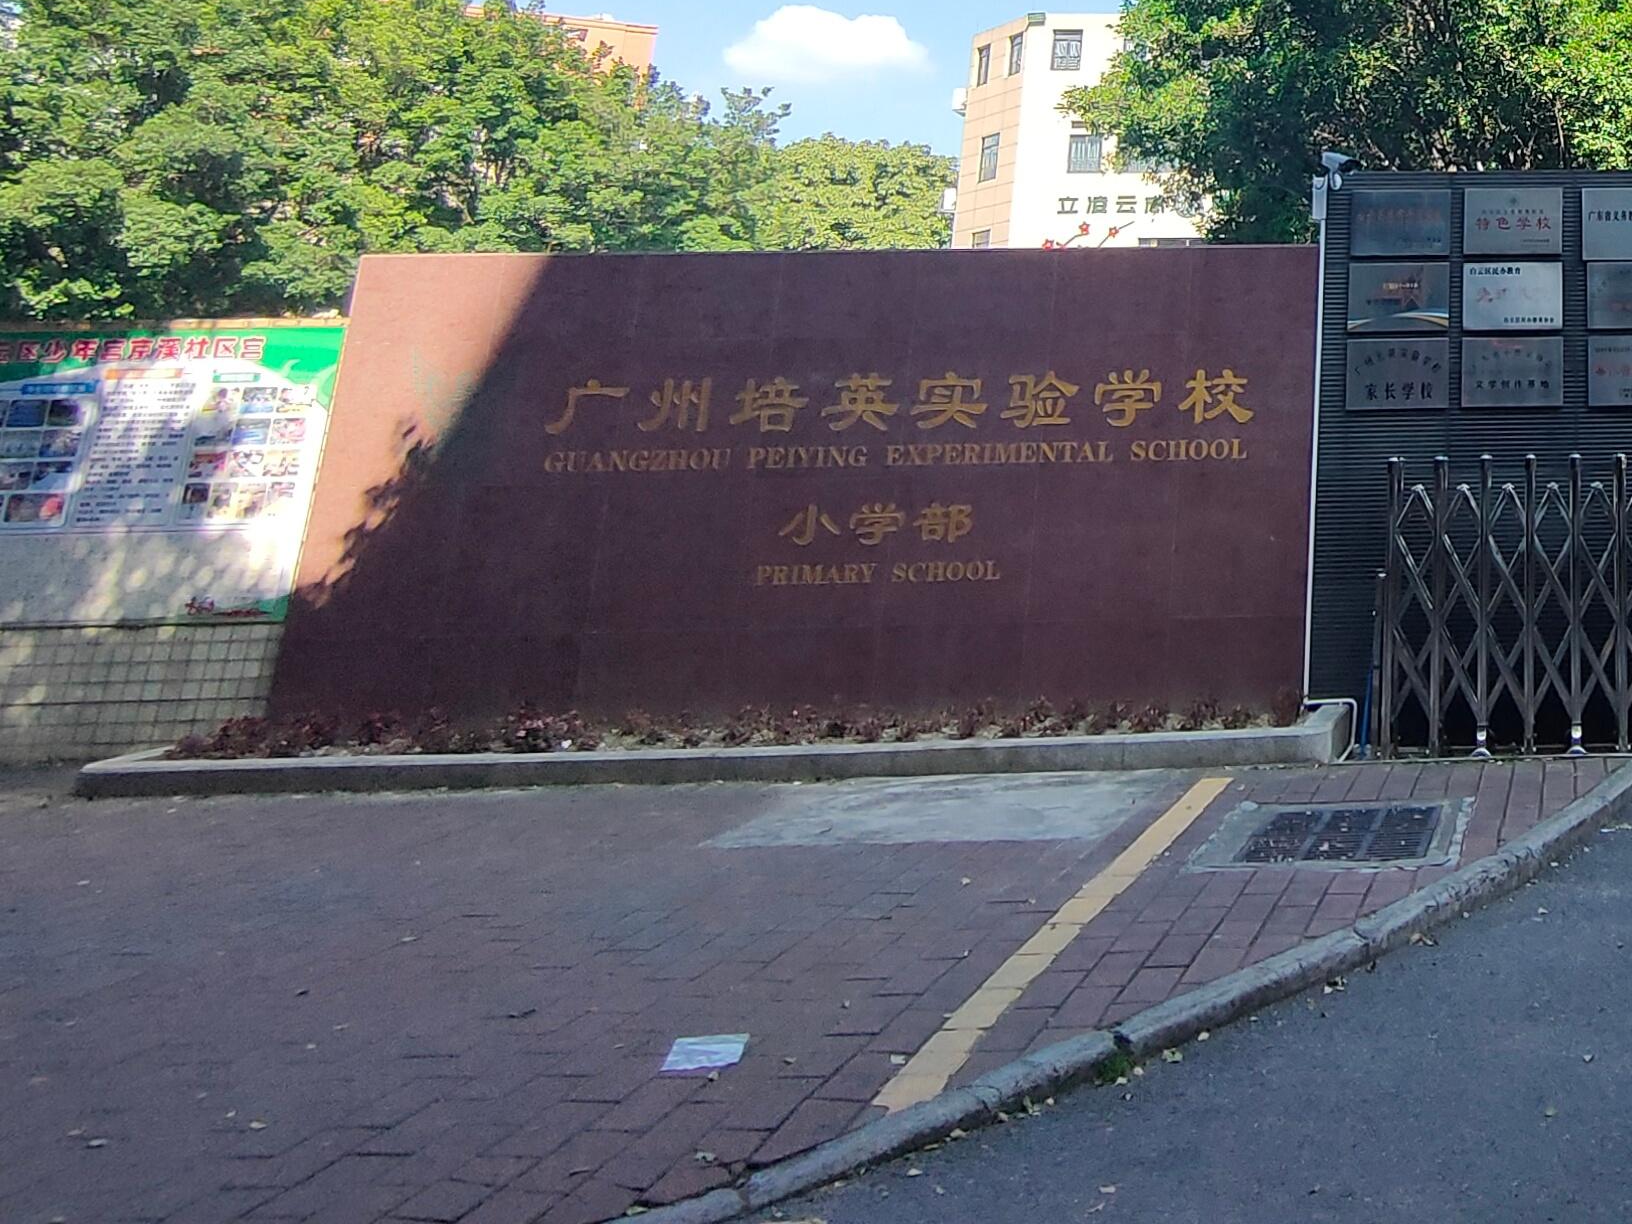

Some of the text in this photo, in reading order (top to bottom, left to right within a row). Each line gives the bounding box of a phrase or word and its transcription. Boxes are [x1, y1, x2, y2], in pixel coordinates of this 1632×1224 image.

[1475, 216, 1552, 231] 特色学校
[545, 369, 1255, 435] 广州培英实验学校
[1365, 381, 1433, 401] 家长学校
[544, 435, 1249, 474] GUANGZHOU PEIYING EXPERIMENTAL SCHOOL
[778, 502, 974, 547] 小学部
[755, 558, 1001, 587] PRIMARY SCHOOL
